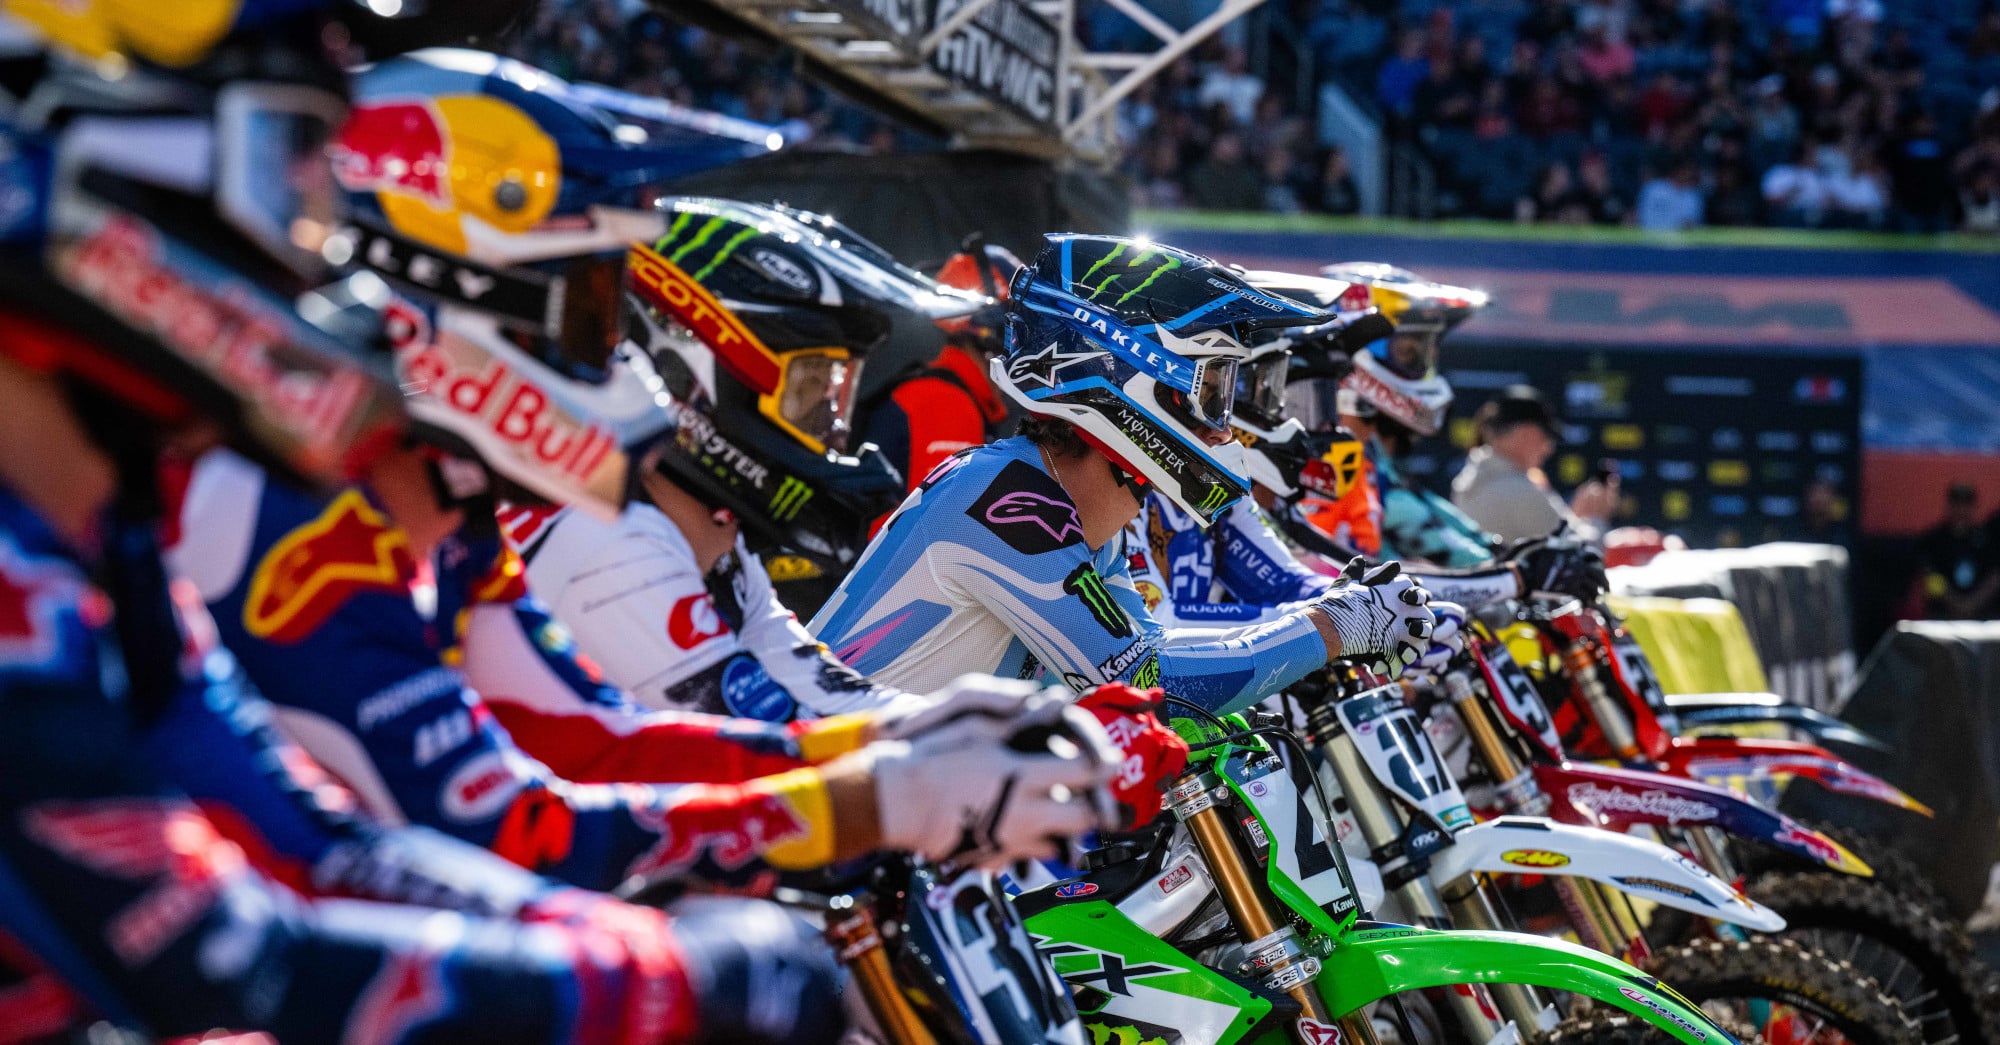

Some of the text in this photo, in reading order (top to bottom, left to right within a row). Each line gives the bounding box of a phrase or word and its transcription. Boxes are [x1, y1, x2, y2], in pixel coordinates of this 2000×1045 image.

[1073, 307, 1179, 374] OAKLEY
[495, 382, 617, 484] Bull
[1117, 408, 1187, 475] MONSTER
[1121, 428, 1170, 472] ENERGY
[1251, 944, 1288, 970] XTRIG
[1358, 930, 1424, 940] SEXTON
